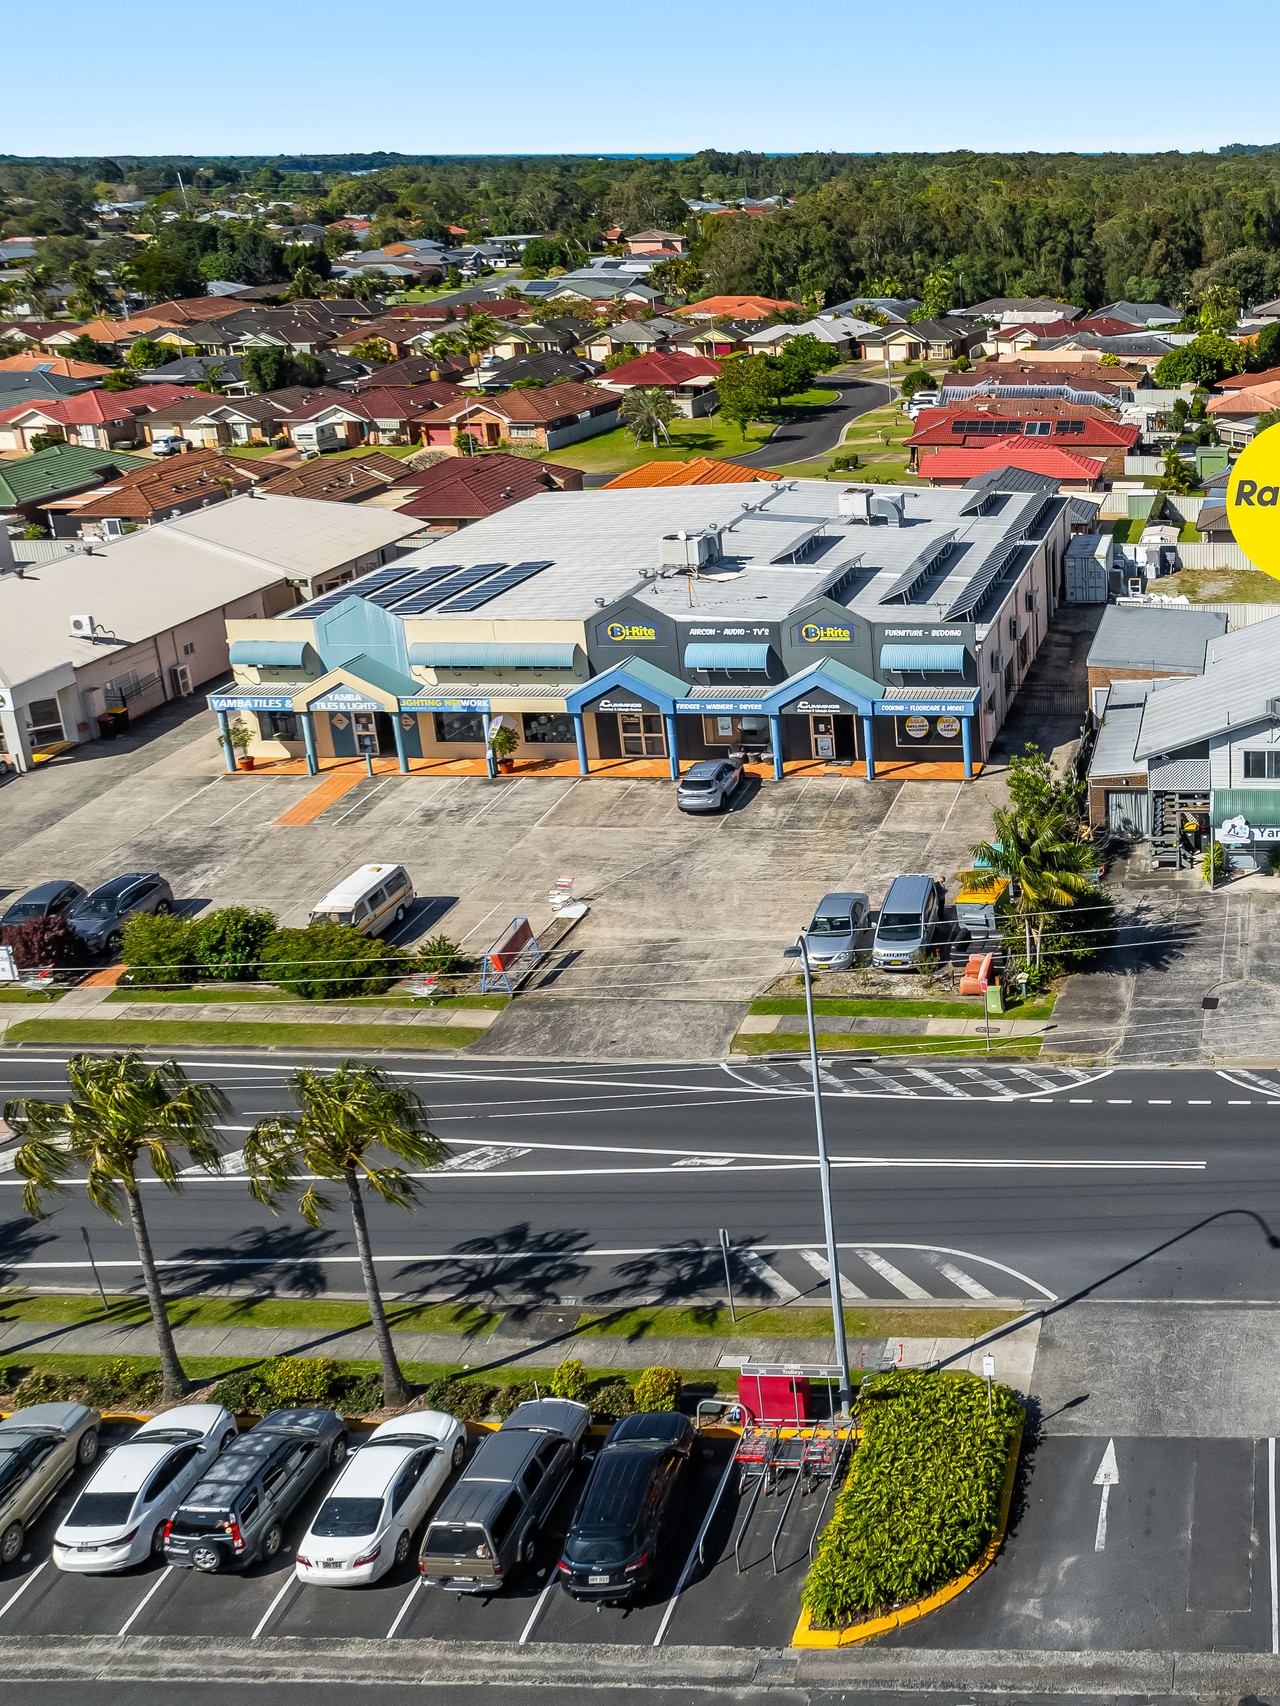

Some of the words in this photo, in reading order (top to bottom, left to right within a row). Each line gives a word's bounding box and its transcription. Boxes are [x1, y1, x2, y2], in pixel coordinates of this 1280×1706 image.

[689, 628, 716, 636] AIRCON
[723, 628, 745, 636] AUDIO
[753, 628, 769, 636] TV'S
[885, 629, 924, 637] FURNITURE
[931, 629, 962, 637] BEDDING
[327, 693, 363, 701] YAMBA
[212, 699, 252, 708] YAMBA
[252, 699, 282, 708] TILES
[316, 702, 339, 710] TILES
[339, 702, 348, 710] &
[349, 702, 378, 710] LIGHTS
[444, 699, 489, 707] NETWORK
[881, 704, 904, 712] COOKING
[910, 704, 941, 712] FLOORCARE
